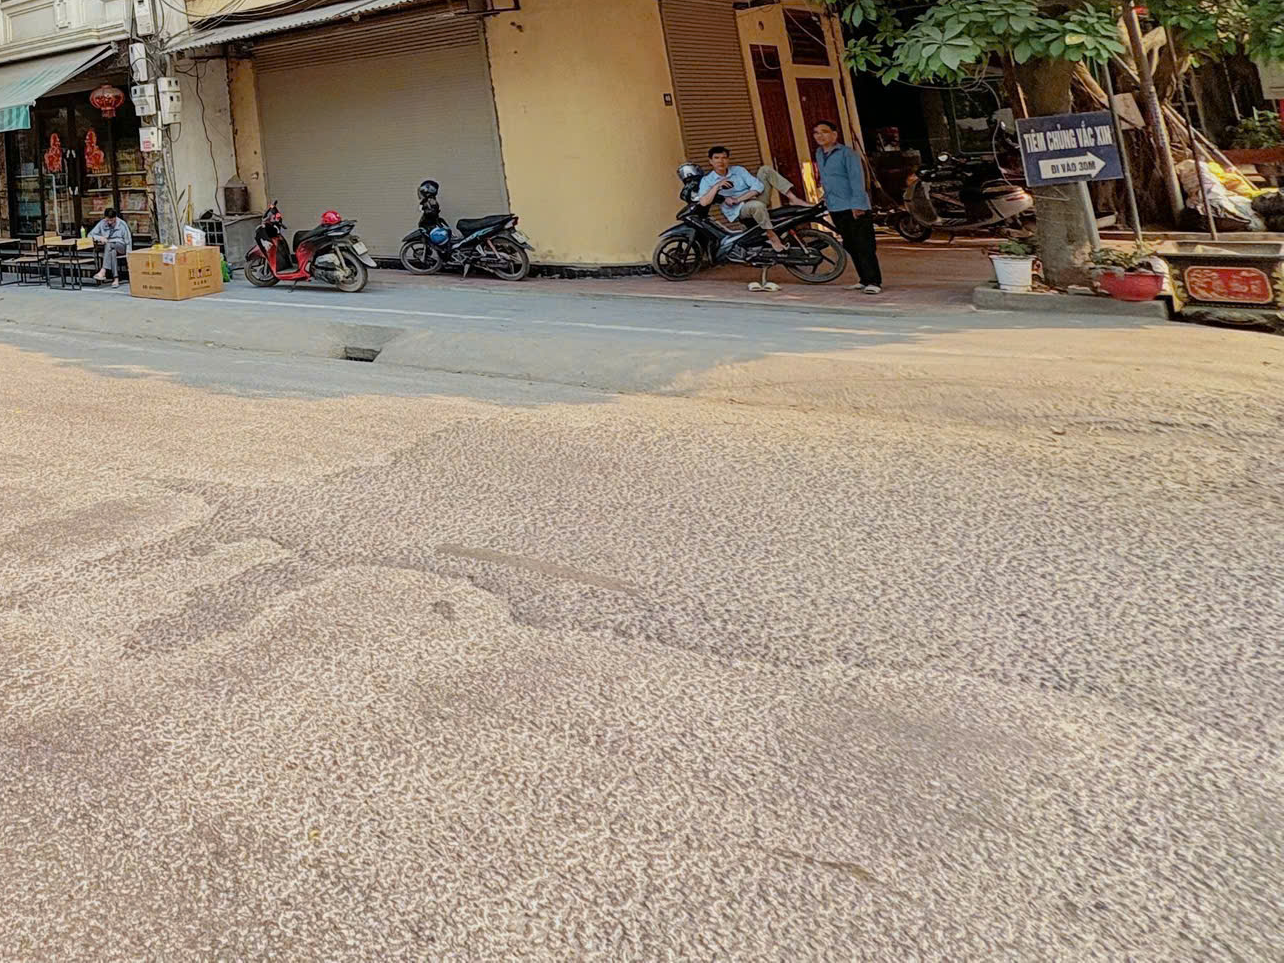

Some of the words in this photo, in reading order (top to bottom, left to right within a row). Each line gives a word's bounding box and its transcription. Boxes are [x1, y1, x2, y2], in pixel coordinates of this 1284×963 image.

[1023, 128, 1047, 153] TIÊM
[1046, 123, 1078, 151] CHỦNG
[1076, 120, 1095, 147] VẮC
[1094, 125, 1113, 146] XIN
